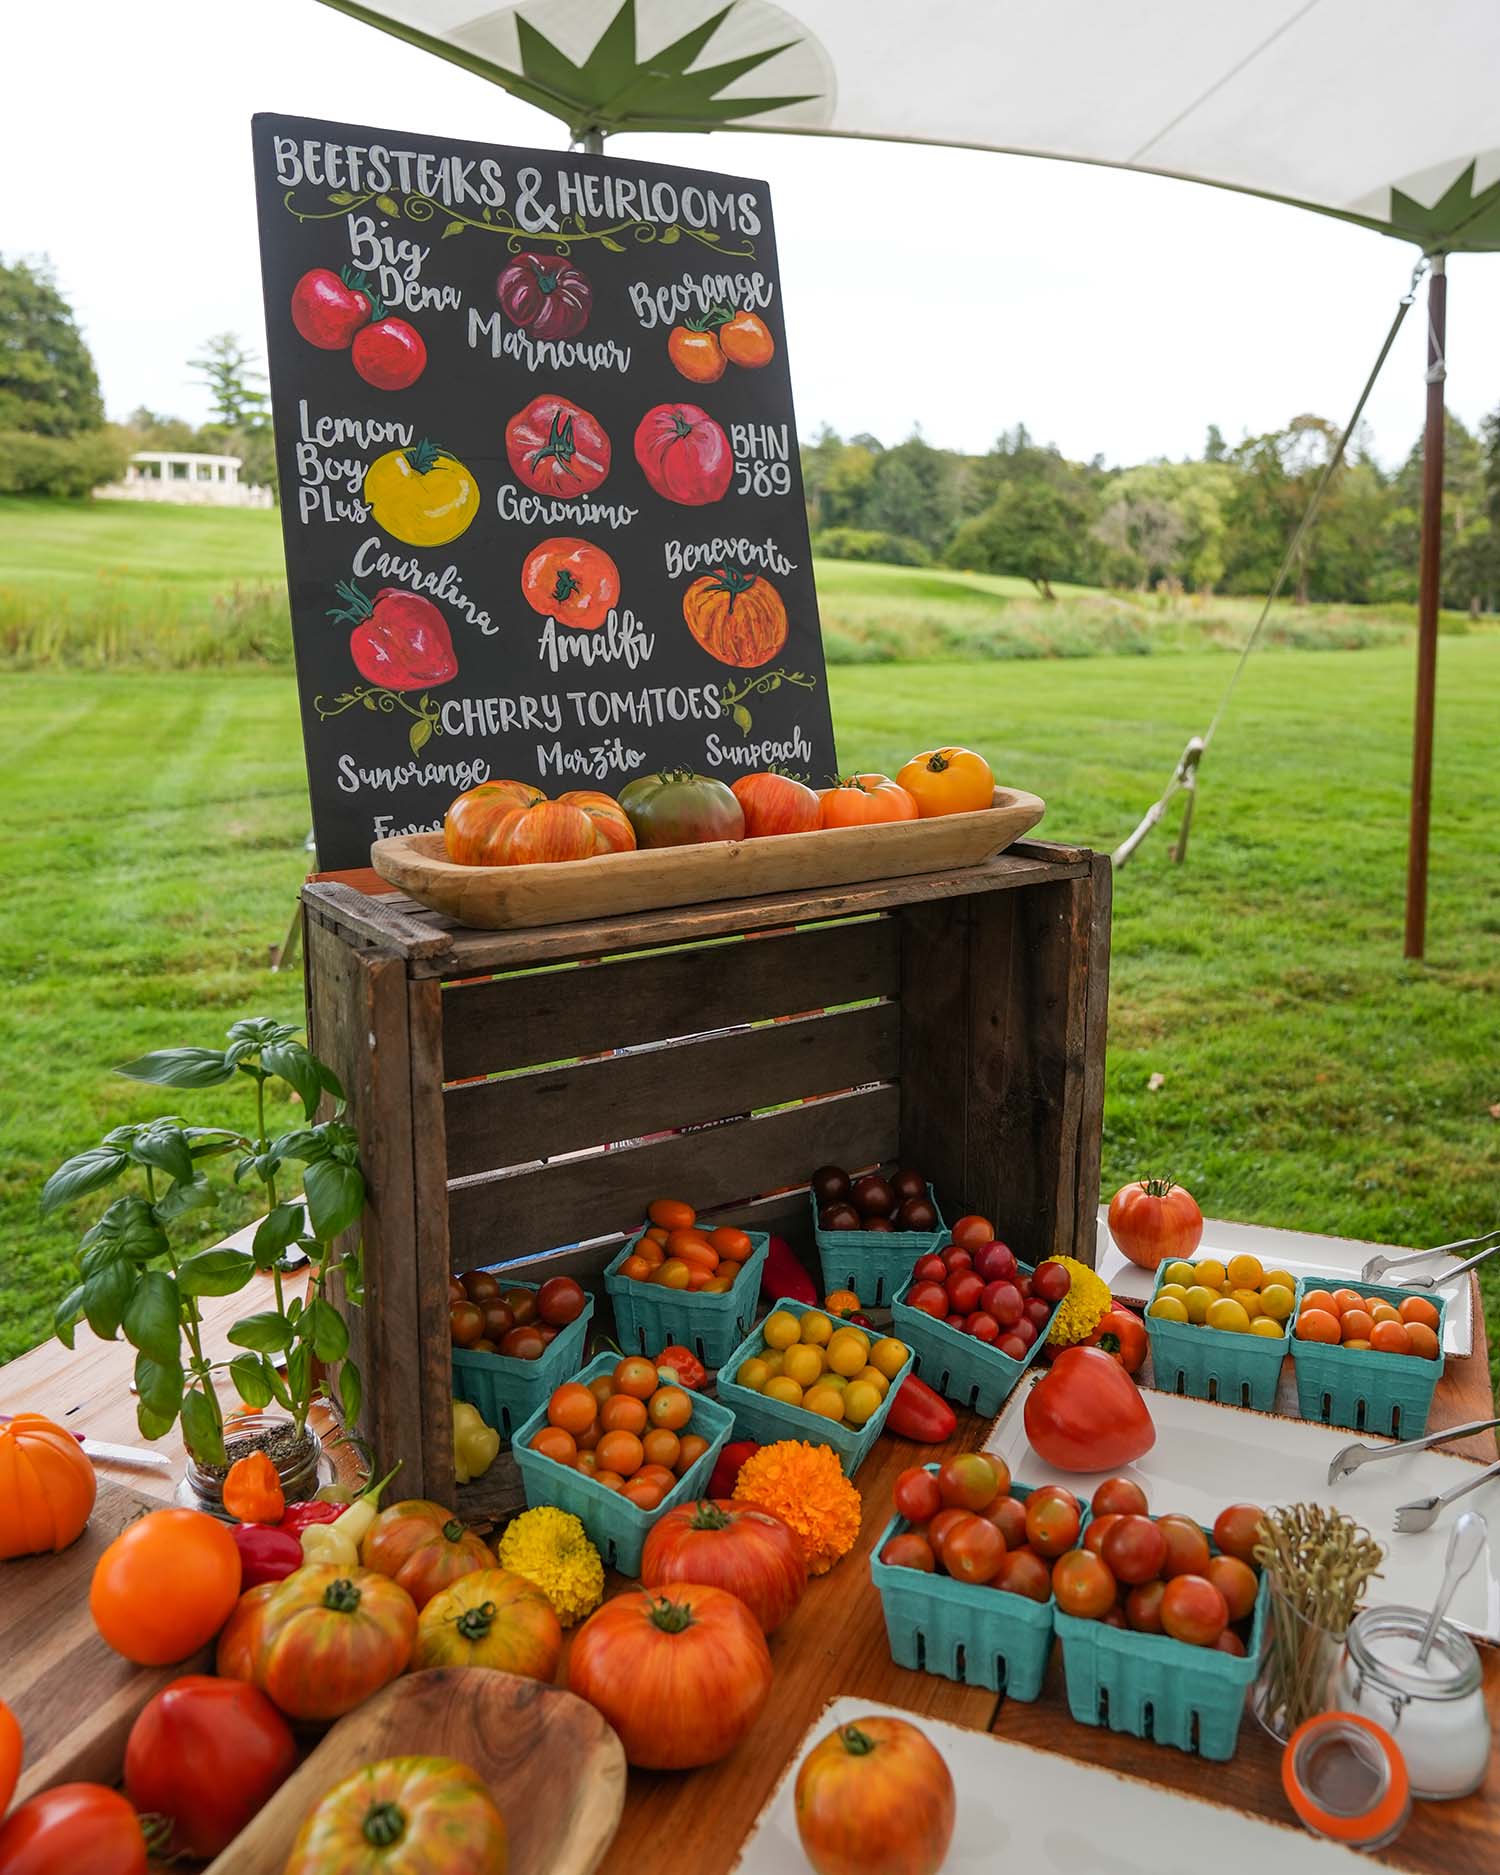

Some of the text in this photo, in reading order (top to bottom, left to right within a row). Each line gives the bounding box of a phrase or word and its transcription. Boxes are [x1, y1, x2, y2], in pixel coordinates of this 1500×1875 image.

[272, 135, 762, 236] BEEFSTEAKS & HEIRLOOMS
[347, 212, 431, 282] Big
[378, 264, 462, 313] Dena
[628, 271, 774, 329] Beorange
[468, 307, 631, 373] Marnouar
[298, 399, 414, 450] Lemon
[730, 423, 789, 462] BHN
[295, 441, 369, 494] Boy
[735, 459, 791, 498] 589
[496, 484, 639, 530] Geronimo
[664, 537, 798, 579] Benevento
[352, 536, 500, 636] Cauralina
[537, 609, 655, 673] Amalfi
[440, 683, 722, 737] CHERRY TOMATOES
[536, 737, 647, 780] Marzito
[705, 725, 812, 767] Sunpeach
[337, 754, 491, 793] Sunorange
